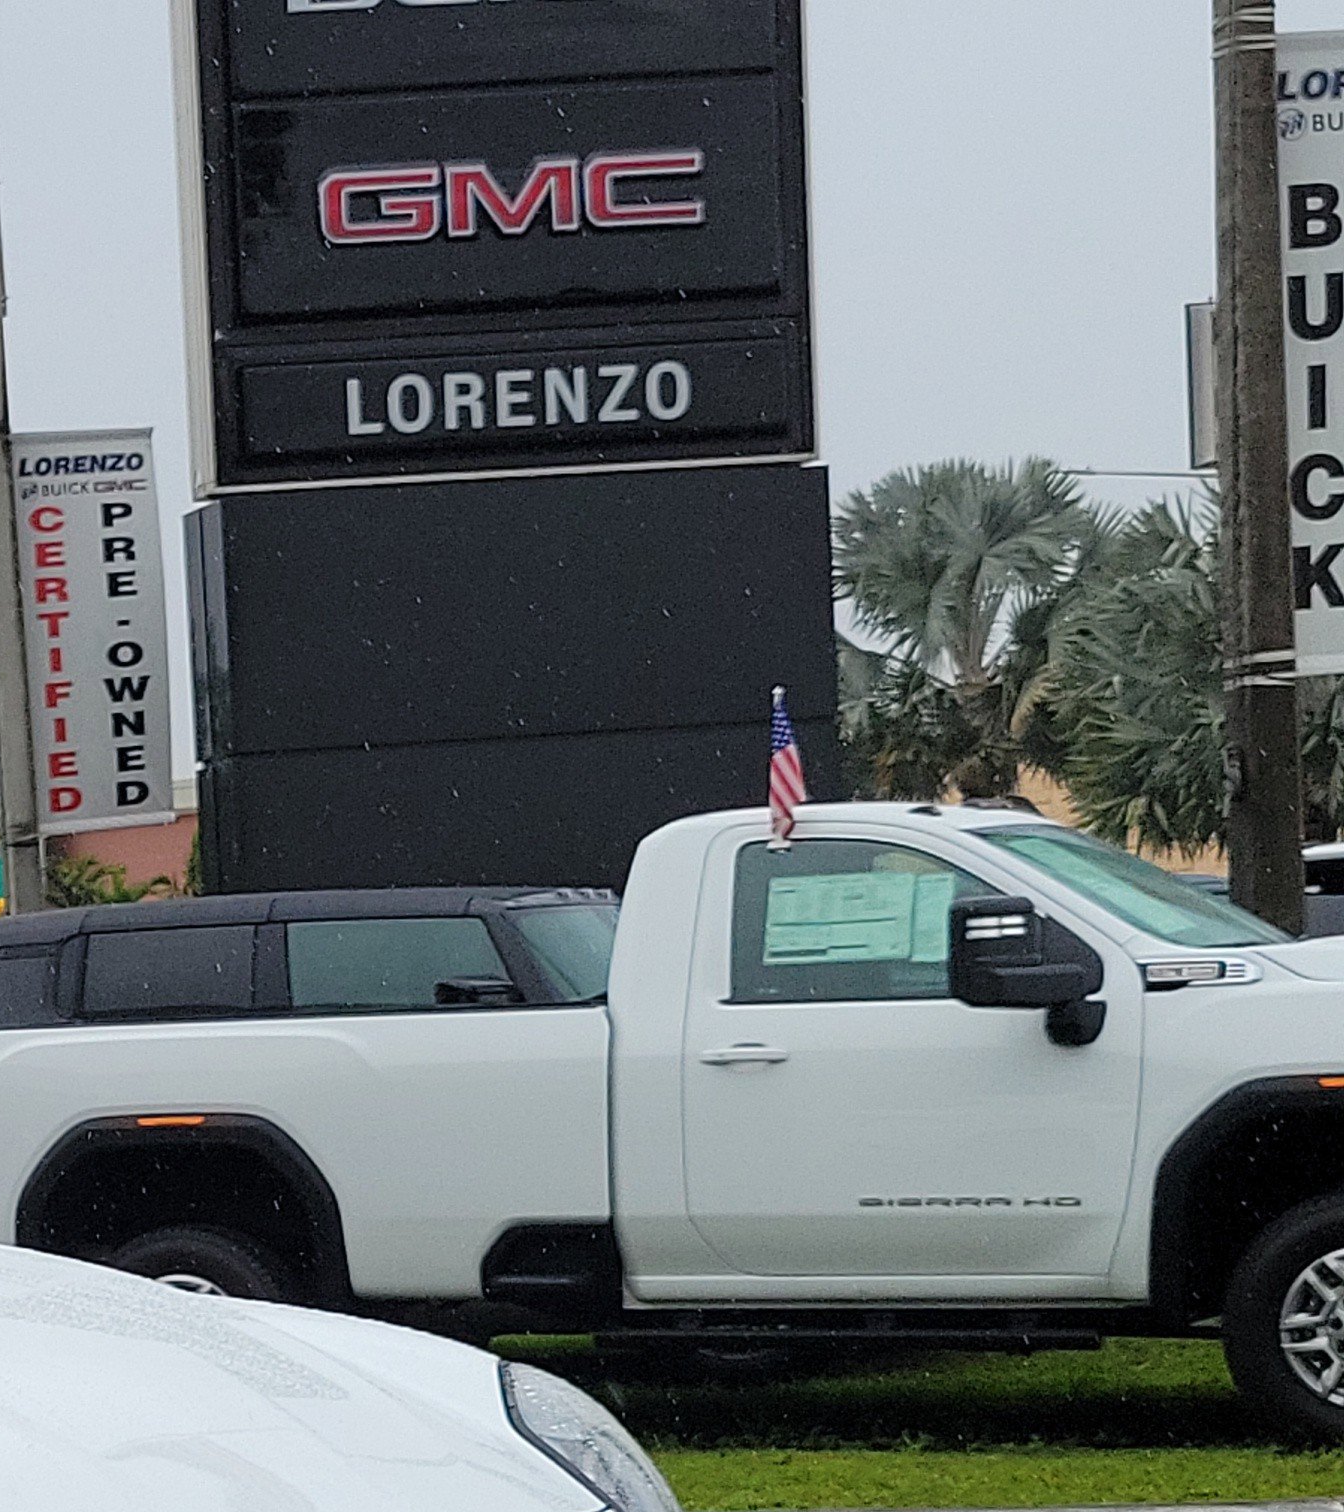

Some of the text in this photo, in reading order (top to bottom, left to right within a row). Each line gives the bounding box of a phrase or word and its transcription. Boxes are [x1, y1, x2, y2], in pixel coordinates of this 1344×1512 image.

[318, 151, 704, 245] GMC
[346, 360, 691, 436] LORENZO
[1287, 182, 1344, 611] BUICK
[19, 453, 144, 477] LORENZO
[41, 479, 148, 497] BUICK GMC
[28, 506, 82, 814] CERTIFIED
[102, 502, 150, 807] PRE-OWNED
[859, 1196, 1081, 1207] SIERRA HD
